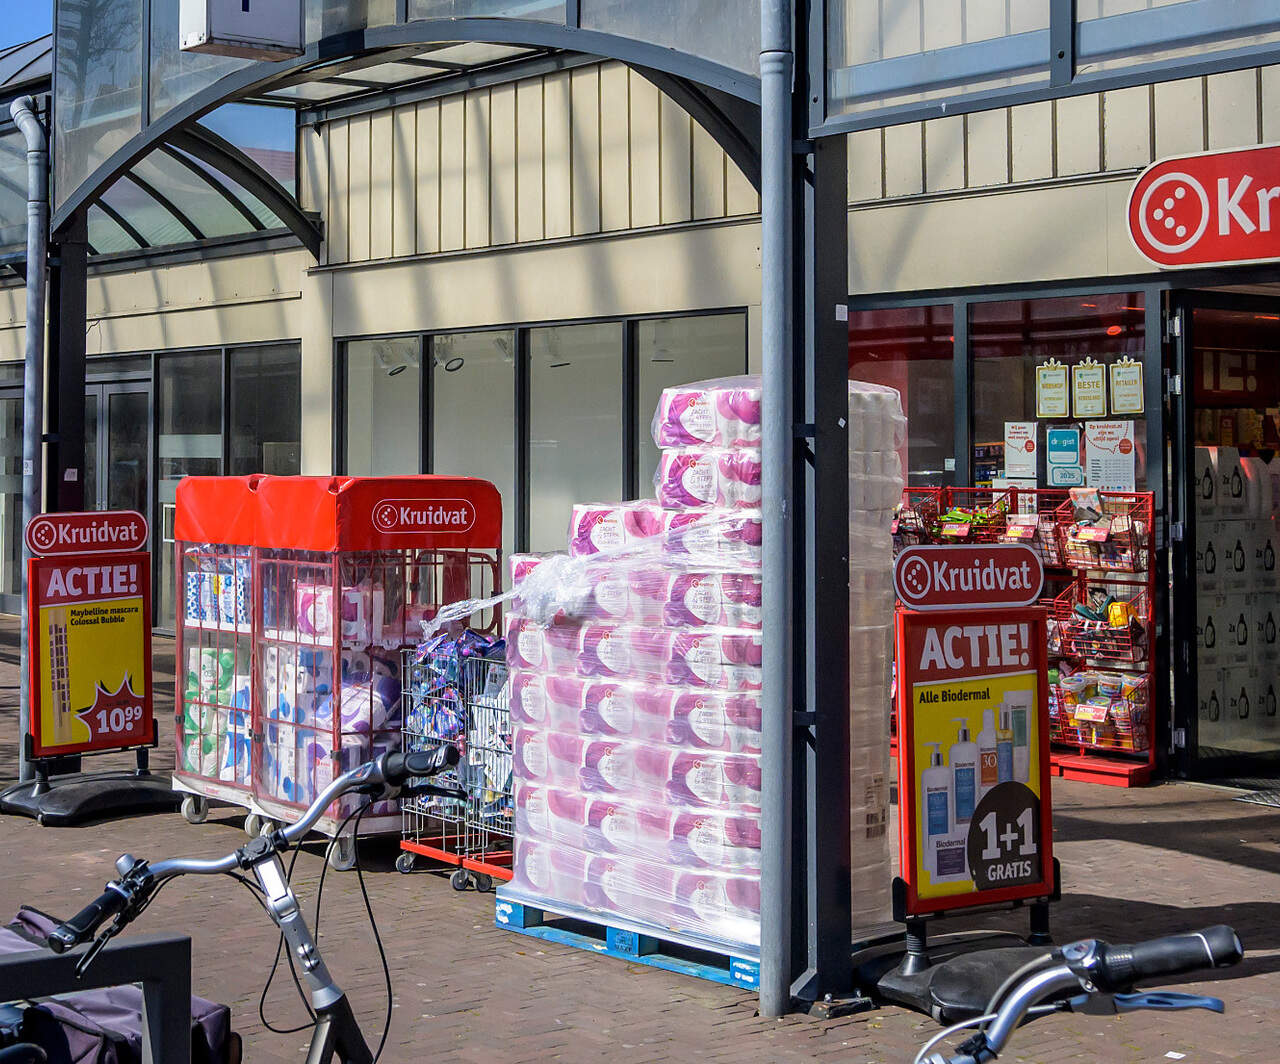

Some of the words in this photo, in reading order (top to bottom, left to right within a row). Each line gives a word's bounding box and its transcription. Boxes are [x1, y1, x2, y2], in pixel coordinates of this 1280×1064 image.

[1077, 381, 1101, 389] BESTE
[400, 505, 468, 525] Kruidvat
[58, 520, 139, 545] Kruidvat
[46, 564, 138, 598] ACTIE!
[933, 558, 1032, 592] Kruidvat
[70, 607, 109, 618] Maybelline
[110, 606, 139, 615] mascara
[70, 616, 100, 626] Colossal
[101, 615, 126, 624] Bubble
[919, 623, 1031, 671] ACTIE!
[919, 689, 939, 704] Alle
[941, 687, 991, 702] Biodermal
[982, 753, 997, 769] 30
[935, 837, 966, 848] Biodermal
[979, 807, 1037, 860] 1+1
[987, 860, 1032, 882] GRATIS
